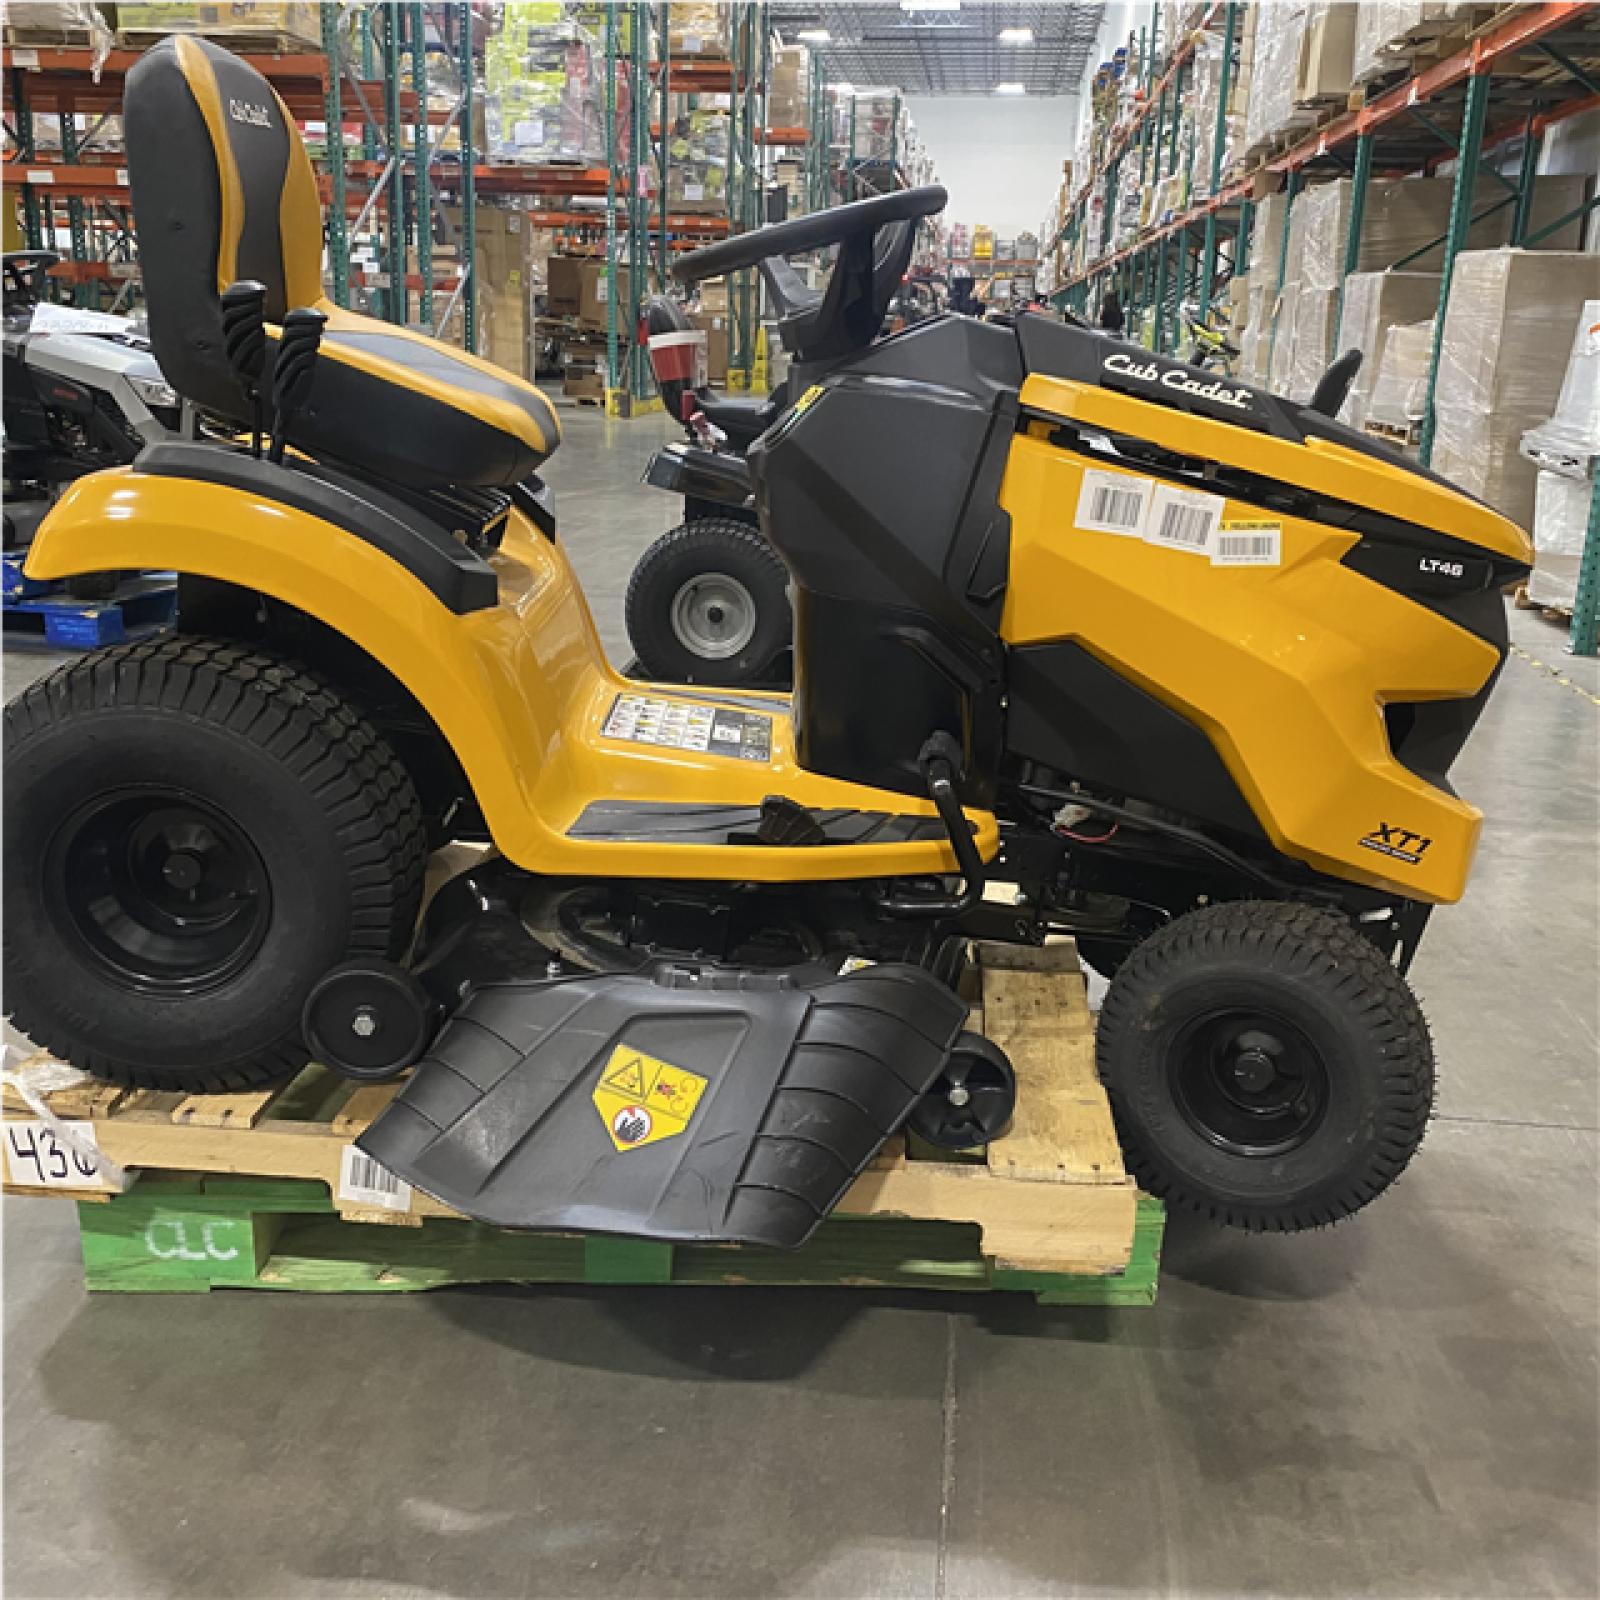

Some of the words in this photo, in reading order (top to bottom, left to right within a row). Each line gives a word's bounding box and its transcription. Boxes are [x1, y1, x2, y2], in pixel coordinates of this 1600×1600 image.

[1104, 354, 1158, 381] Cub
[1160, 369, 1251, 408] Cadet
[1368, 822, 1433, 853] XT1
